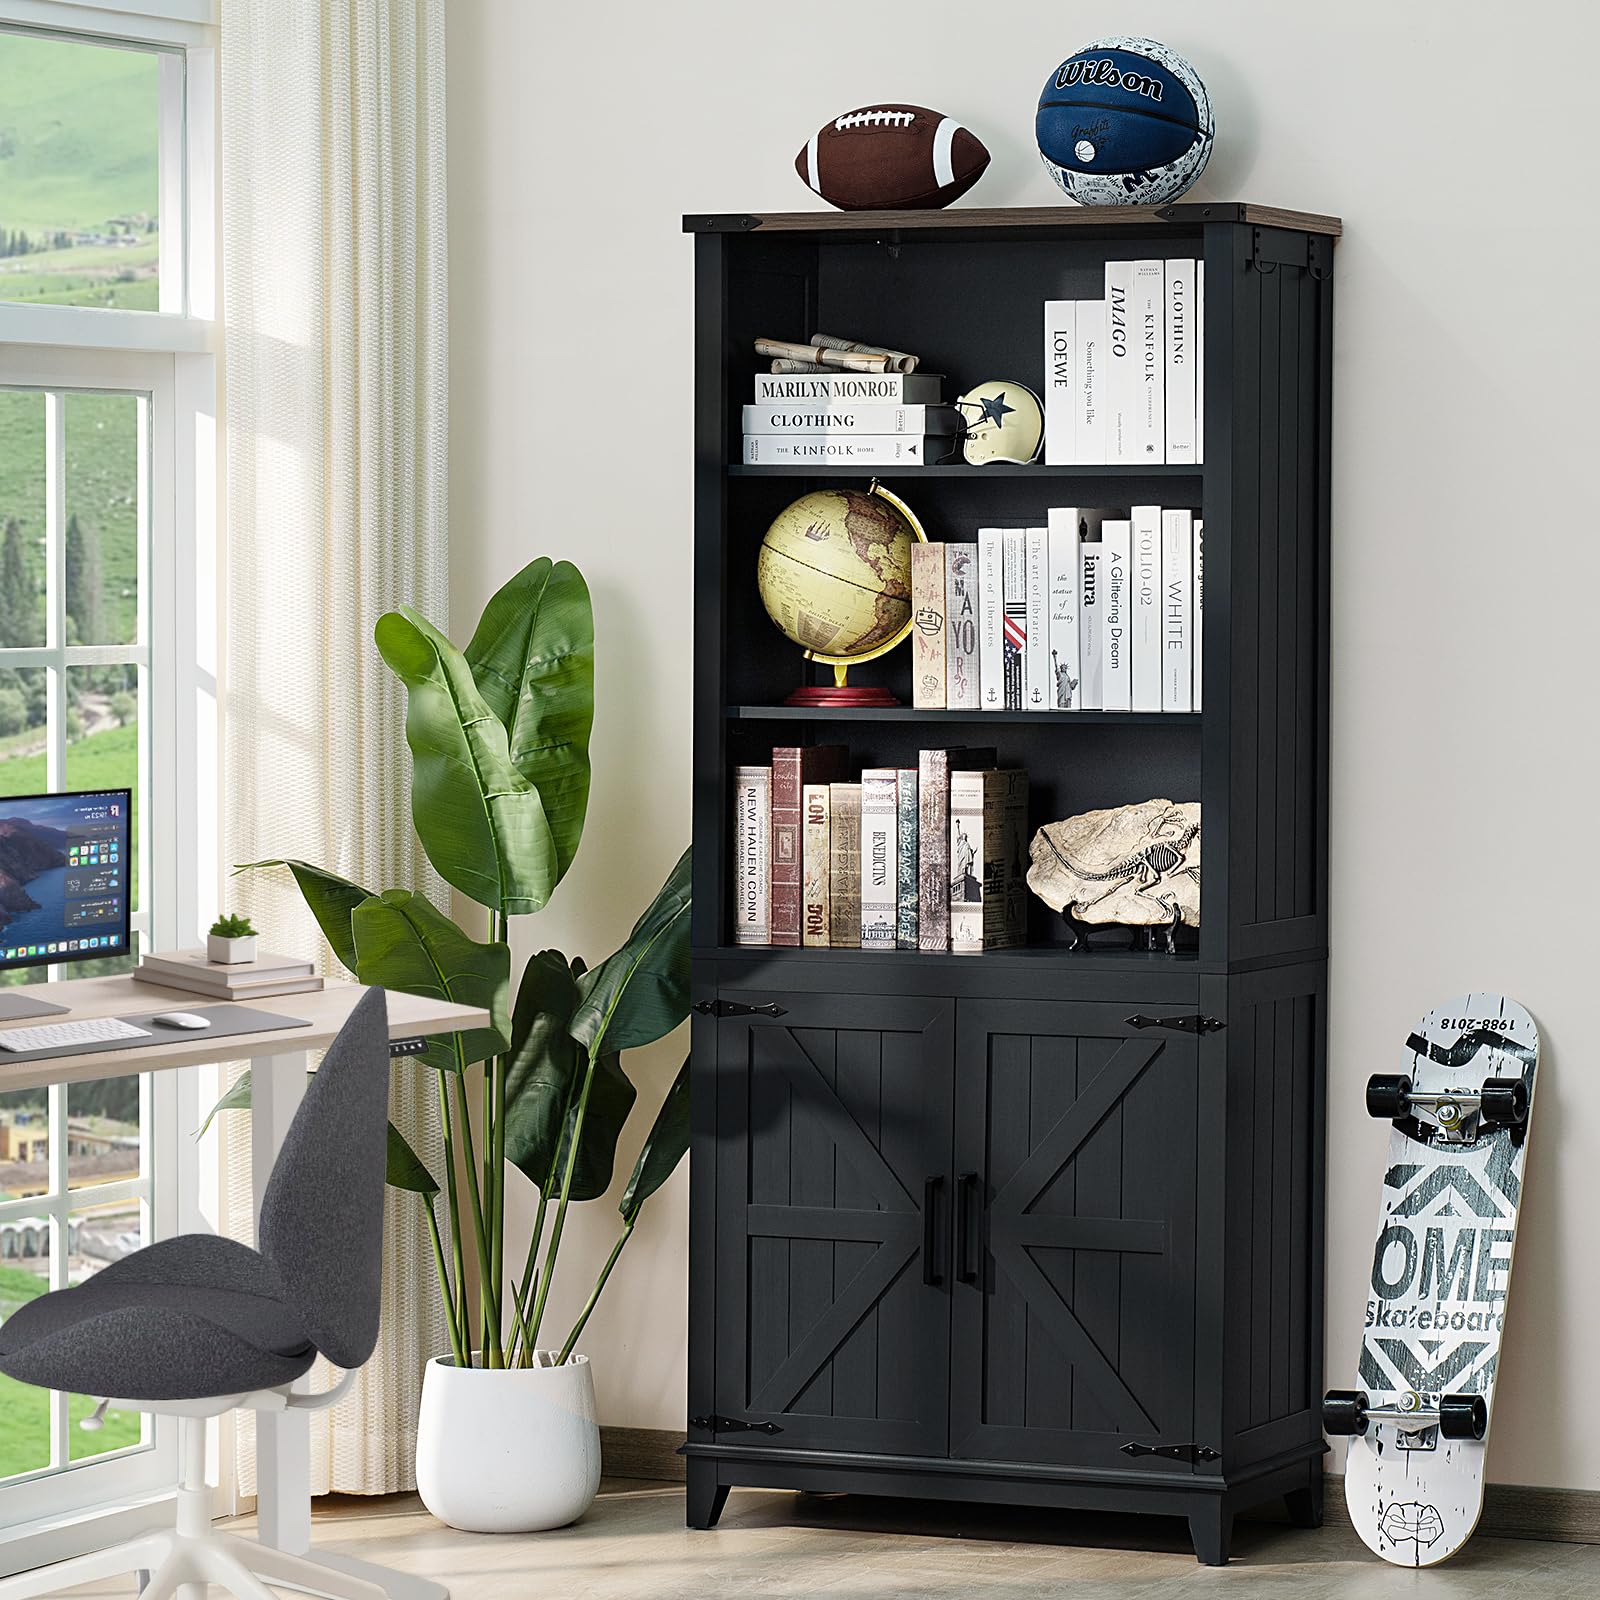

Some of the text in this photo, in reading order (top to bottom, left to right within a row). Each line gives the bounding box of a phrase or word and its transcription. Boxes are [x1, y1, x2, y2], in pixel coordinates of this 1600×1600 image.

[1055, 58, 1164, 102] Wilson
[1111, 286, 1127, 358] IMAGO
[1144, 314, 1154, 383] KINFOLK
[1173, 279, 1184, 365] CLOTHING
[1053, 330, 1068, 388] LOEWE
[1083, 341, 1095, 425] Something you like
[762, 380, 898, 398] MARILYN MONROE
[770, 414, 855, 427] CLOTHING
[793, 445, 854, 456] KINFOLK
[1032, 539, 1041, 648] The art of libraries
[1057, 574, 1068, 582] the
[1083, 554, 1100, 607] ianra
[1140, 529, 1153, 606] FOLIO-02
[986, 541, 995, 648] The art of libraries
[1052, 612, 1075, 624] liberty
[1058, 600, 1068, 610] of
[1108, 552, 1124, 669] A Glittering Dream
[1168, 580, 1183, 650] WHITE
[747, 788, 757, 822] NEW
[872, 831, 887, 887] BENEDICTINS
[747, 881, 757, 922] CONN
[807, 903, 824, 936] DON
[1440, 1018, 1516, 1031] 1988-2018
